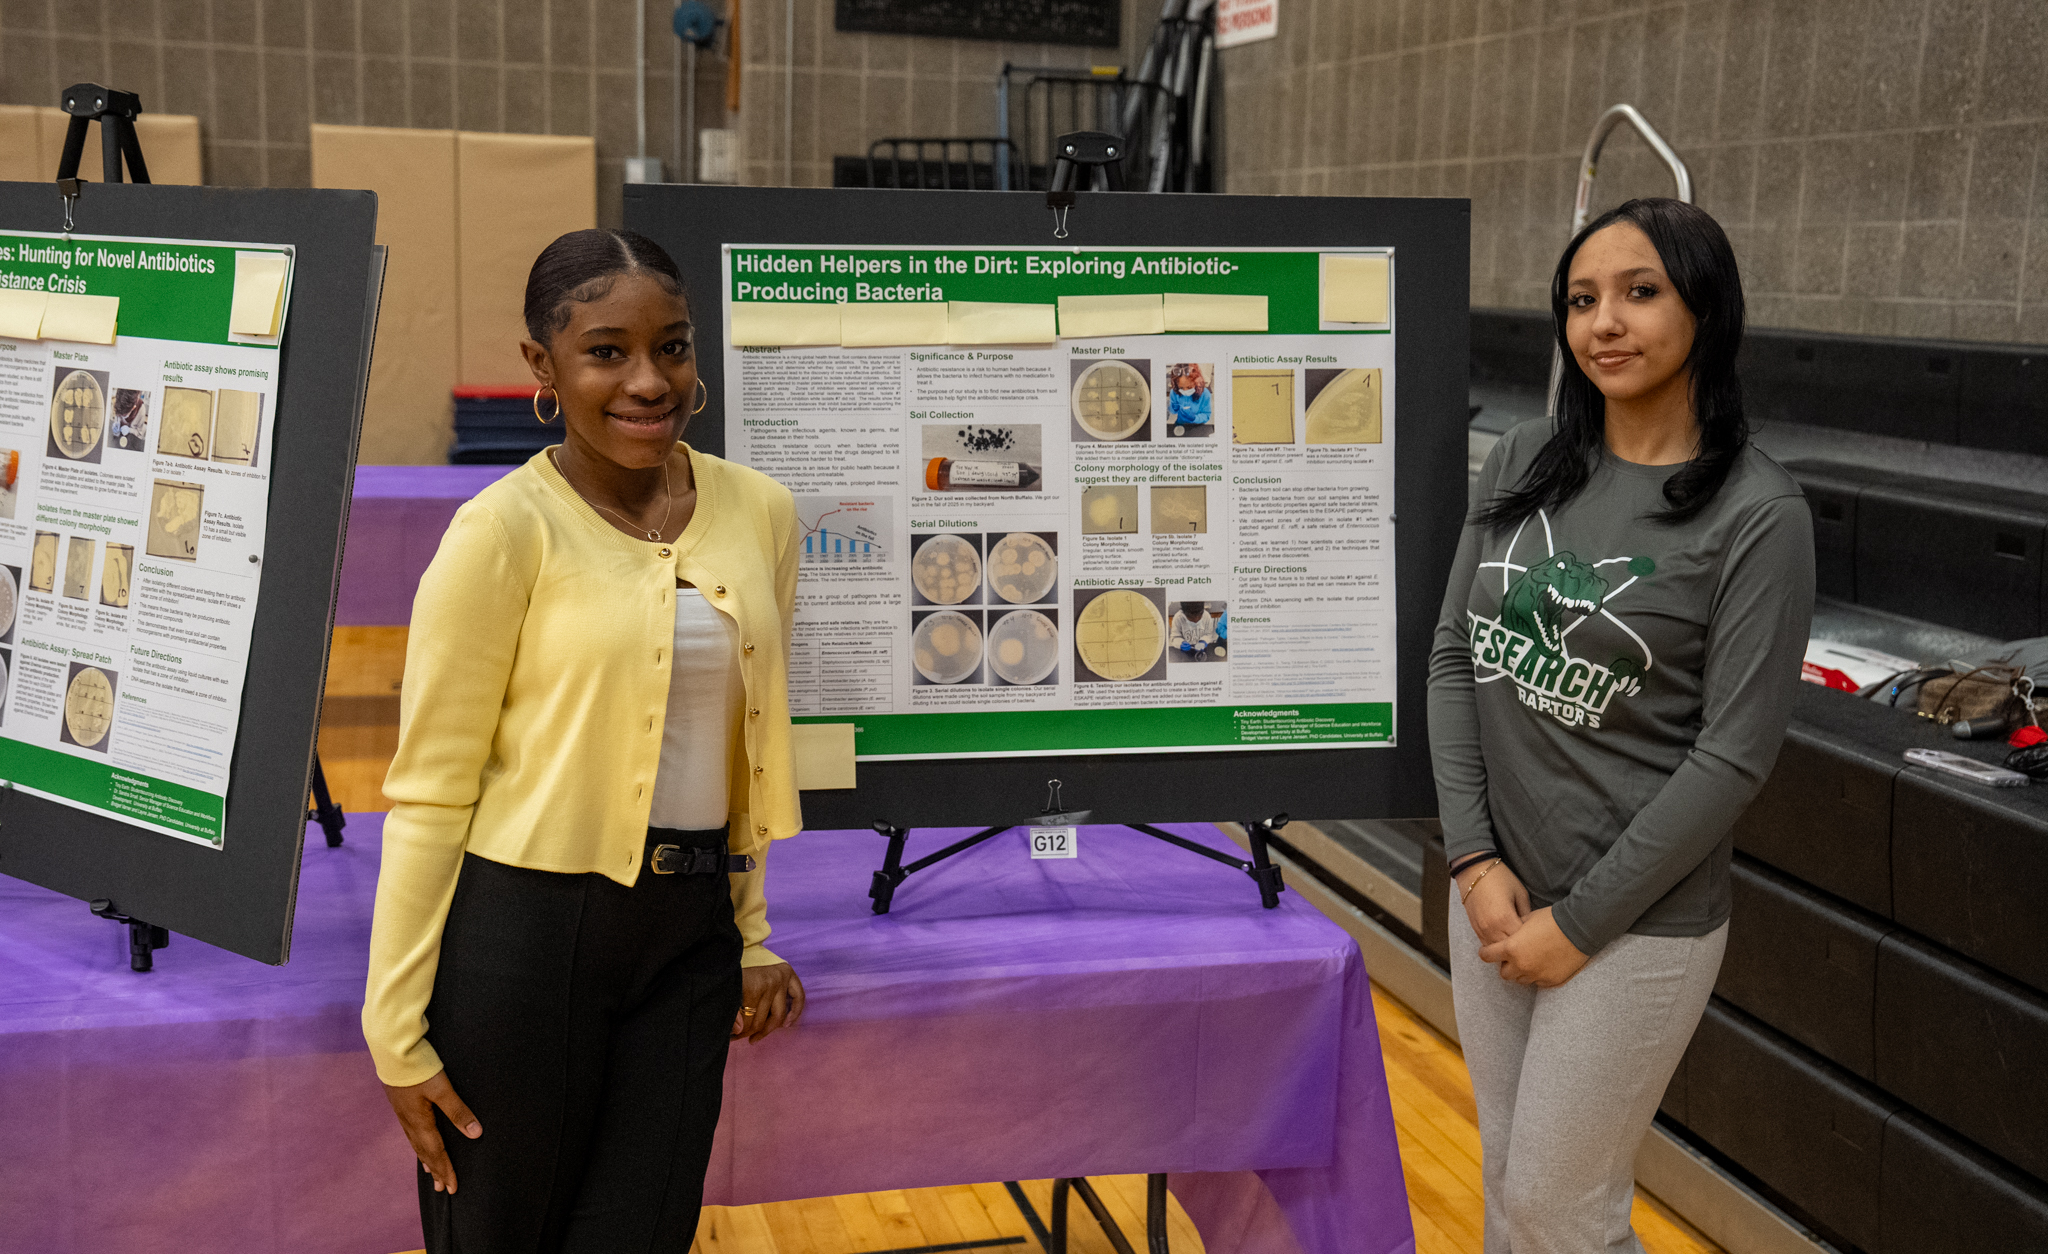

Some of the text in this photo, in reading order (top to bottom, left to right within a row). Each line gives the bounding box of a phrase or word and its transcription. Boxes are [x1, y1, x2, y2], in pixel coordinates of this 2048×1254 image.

[19, 244, 72, 269] Hunting
[75, 247, 94, 266] for
[97, 248, 135, 269] Novel
[138, 251, 215, 274] Antibiotics
[737, 254, 1239, 279] Hidden Helpers in the Dirt: Exploring Antibiotic-
[48, 273, 87, 294] Crisis
[737, 282, 943, 303] Producing Bacteria
[53, 350, 89, 362] Master Plate
[742, 346, 781, 354] Abstract
[1072, 346, 1125, 355] Master Plate
[910, 352, 1014, 362] Significance & Purpose
[1233, 355, 1338, 365] Antibiotic Assay Results
[163, 360, 269, 380] Antibiotic assay shows promising
[163, 373, 183, 383] results
[910, 410, 974, 419] Soil Collection
[744, 418, 799, 427] Introduction
[1074, 464, 1105, 474] Colony
[1108, 464, 1160, 473] morphology
[1162, 463, 1171, 471] of
[1075, 476, 1110, 485] suggest
[1112, 475, 1131, 484] they
[1149, 474, 1185, 482] different
[1233, 476, 1282, 484] Conclusion
[37, 502, 139, 527] Isolates from the master plate showed
[36, 514, 112, 535] different colony morphology
[911, 519, 978, 528] Serial Dilutions
[138, 563, 174, 578] Conclusion
[1234, 565, 1307, 574] Future Directions
[1074, 578, 1116, 586] Antibiotic
[1118, 578, 1144, 587] Assay
[1154, 577, 1185, 586] Spread
[1187, 576, 1212, 584] Patch
[21, 637, 112, 665] Antibiotic Assay: Spread Patch
[130, 645, 183, 664] Future Directions
[1467, 612, 1616, 712] ESEARCH
[121, 691, 147, 704] References
[1516, 685, 1601, 729] RAPTORS
[1233, 709, 1300, 719] Acknowledgments
[1034, 835, 1066, 852] G12
